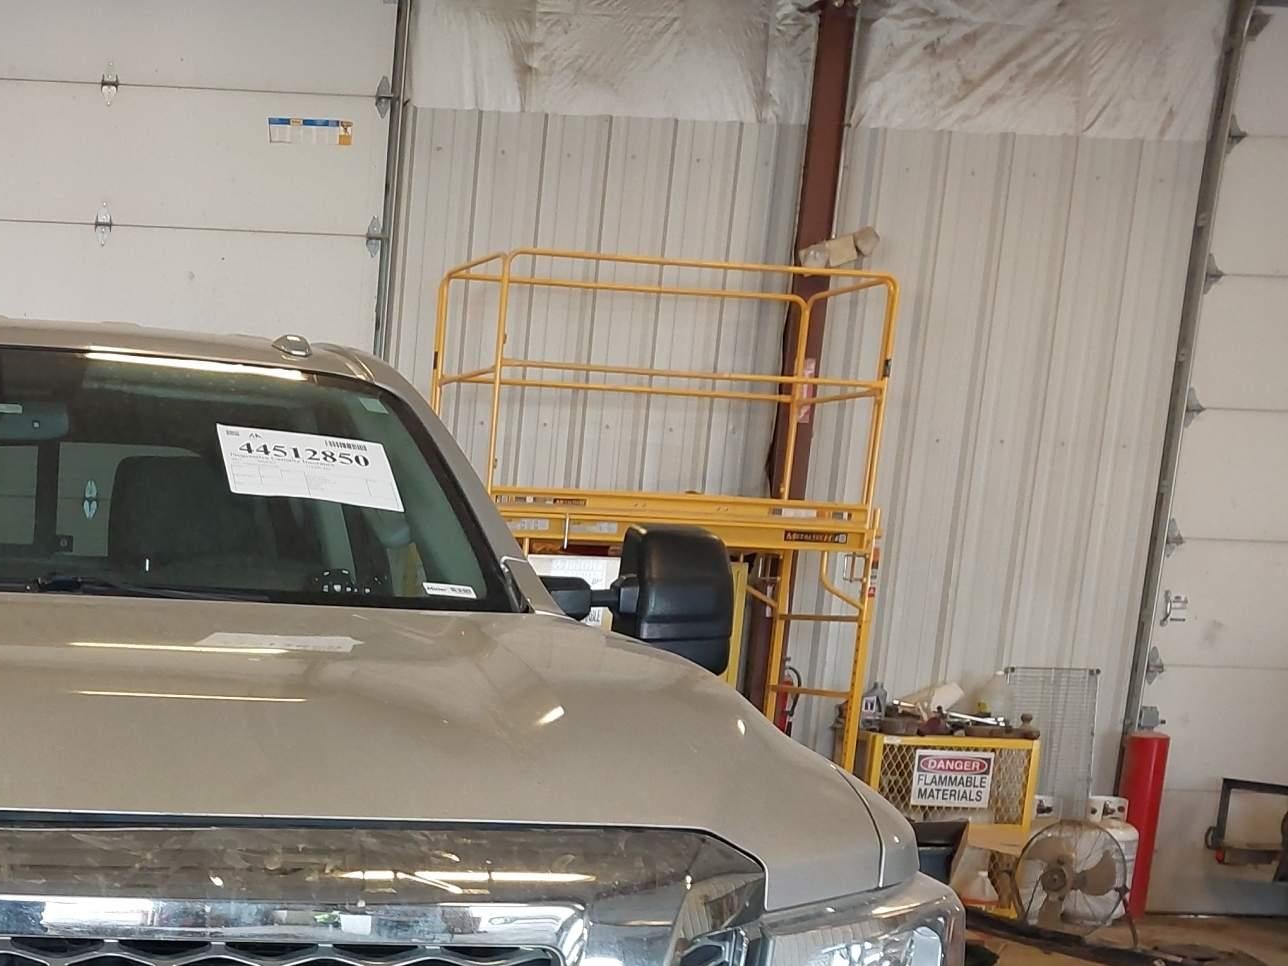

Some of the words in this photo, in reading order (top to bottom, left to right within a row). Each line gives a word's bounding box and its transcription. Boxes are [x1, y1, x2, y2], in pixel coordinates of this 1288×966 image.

[239, 441, 370, 468] 44512850
[927, 758, 981, 771] DANGER
[917, 773, 987, 788] FLAMMABLE
[917, 788, 983, 802] MATERIALS
